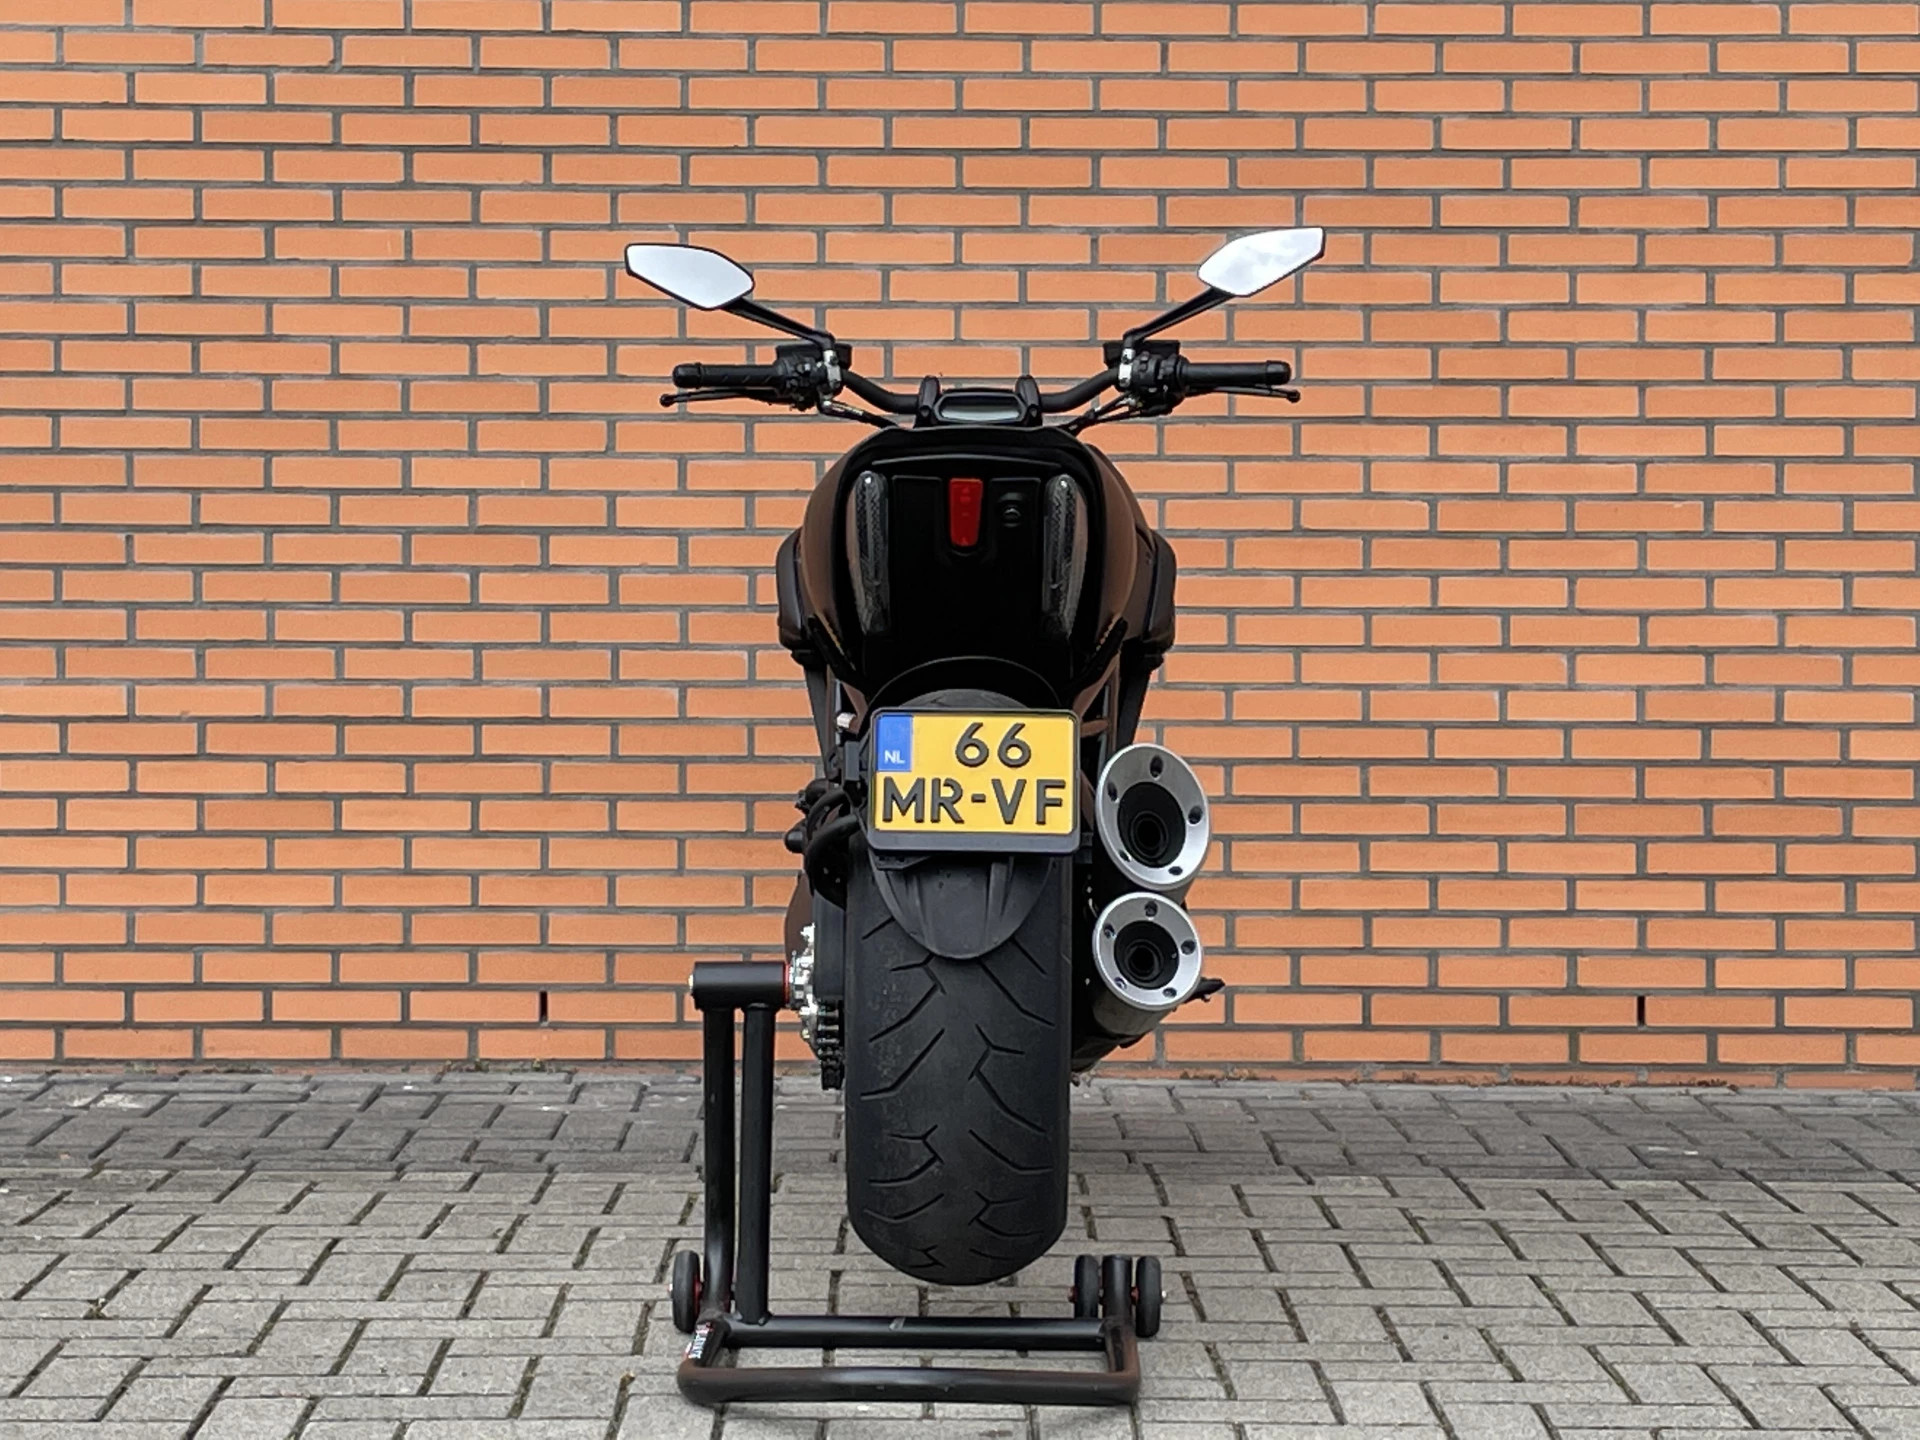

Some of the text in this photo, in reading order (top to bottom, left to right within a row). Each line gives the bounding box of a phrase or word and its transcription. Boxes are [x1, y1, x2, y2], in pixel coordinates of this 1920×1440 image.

[884, 750, 905, 764] NL
[955, 722, 1032, 768] 66
[882, 776, 1066, 825] MR-VF
